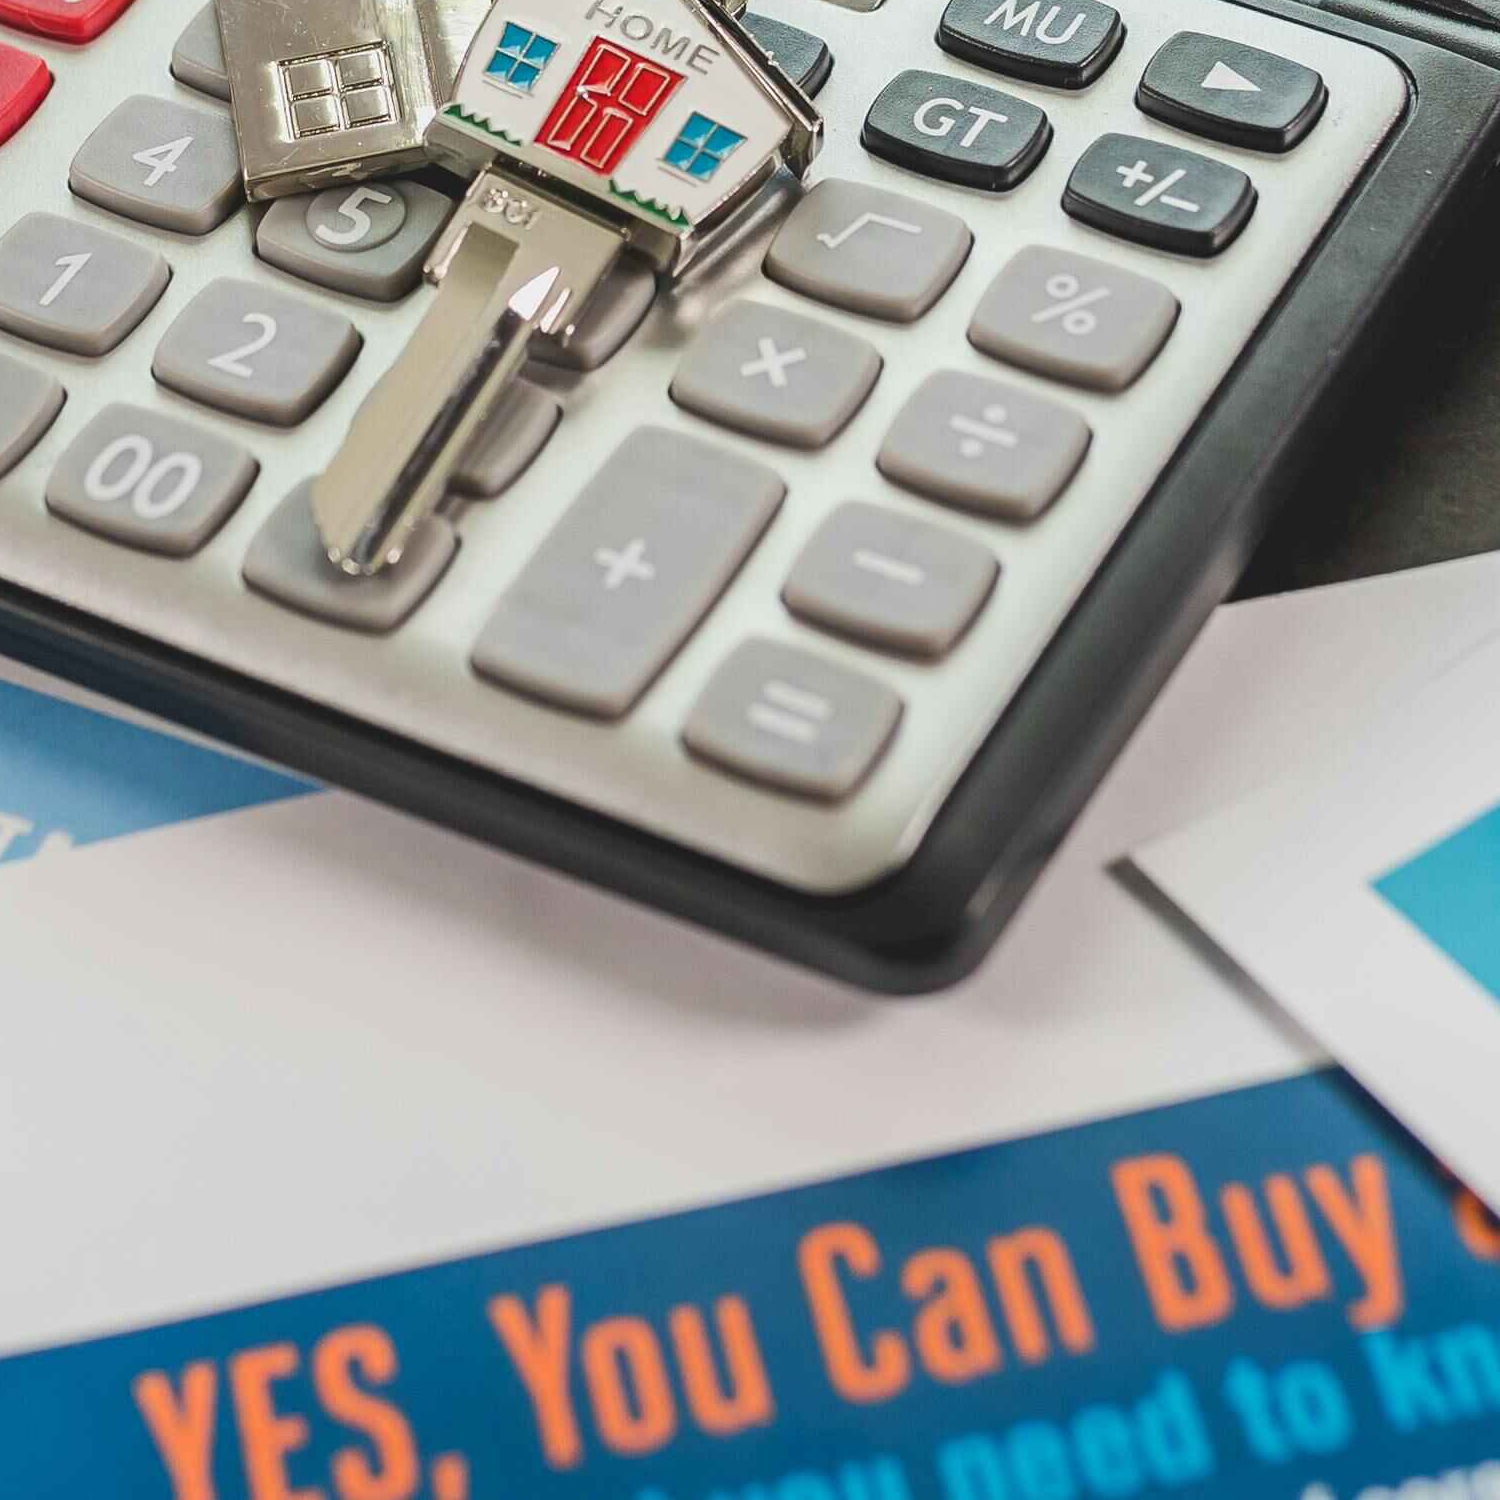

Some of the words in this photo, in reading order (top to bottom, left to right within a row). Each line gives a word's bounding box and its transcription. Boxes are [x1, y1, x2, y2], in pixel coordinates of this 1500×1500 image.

[911, 95, 1011, 150] GT
[132, 135, 196, 188] 4
[314, 187, 393, 247] 5
[38, 252, 95, 306] 1
[1030, 273, 1112, 337] %
[206, 312, 279, 380] 2
[84, 434, 202, 520] 00
[129, 1322, 470, 1500] YES,
[795, 1220, 1096, 1406] Can
[1110, 1151, 1407, 1334] Buy
[1220, 1354, 1354, 1462] to
